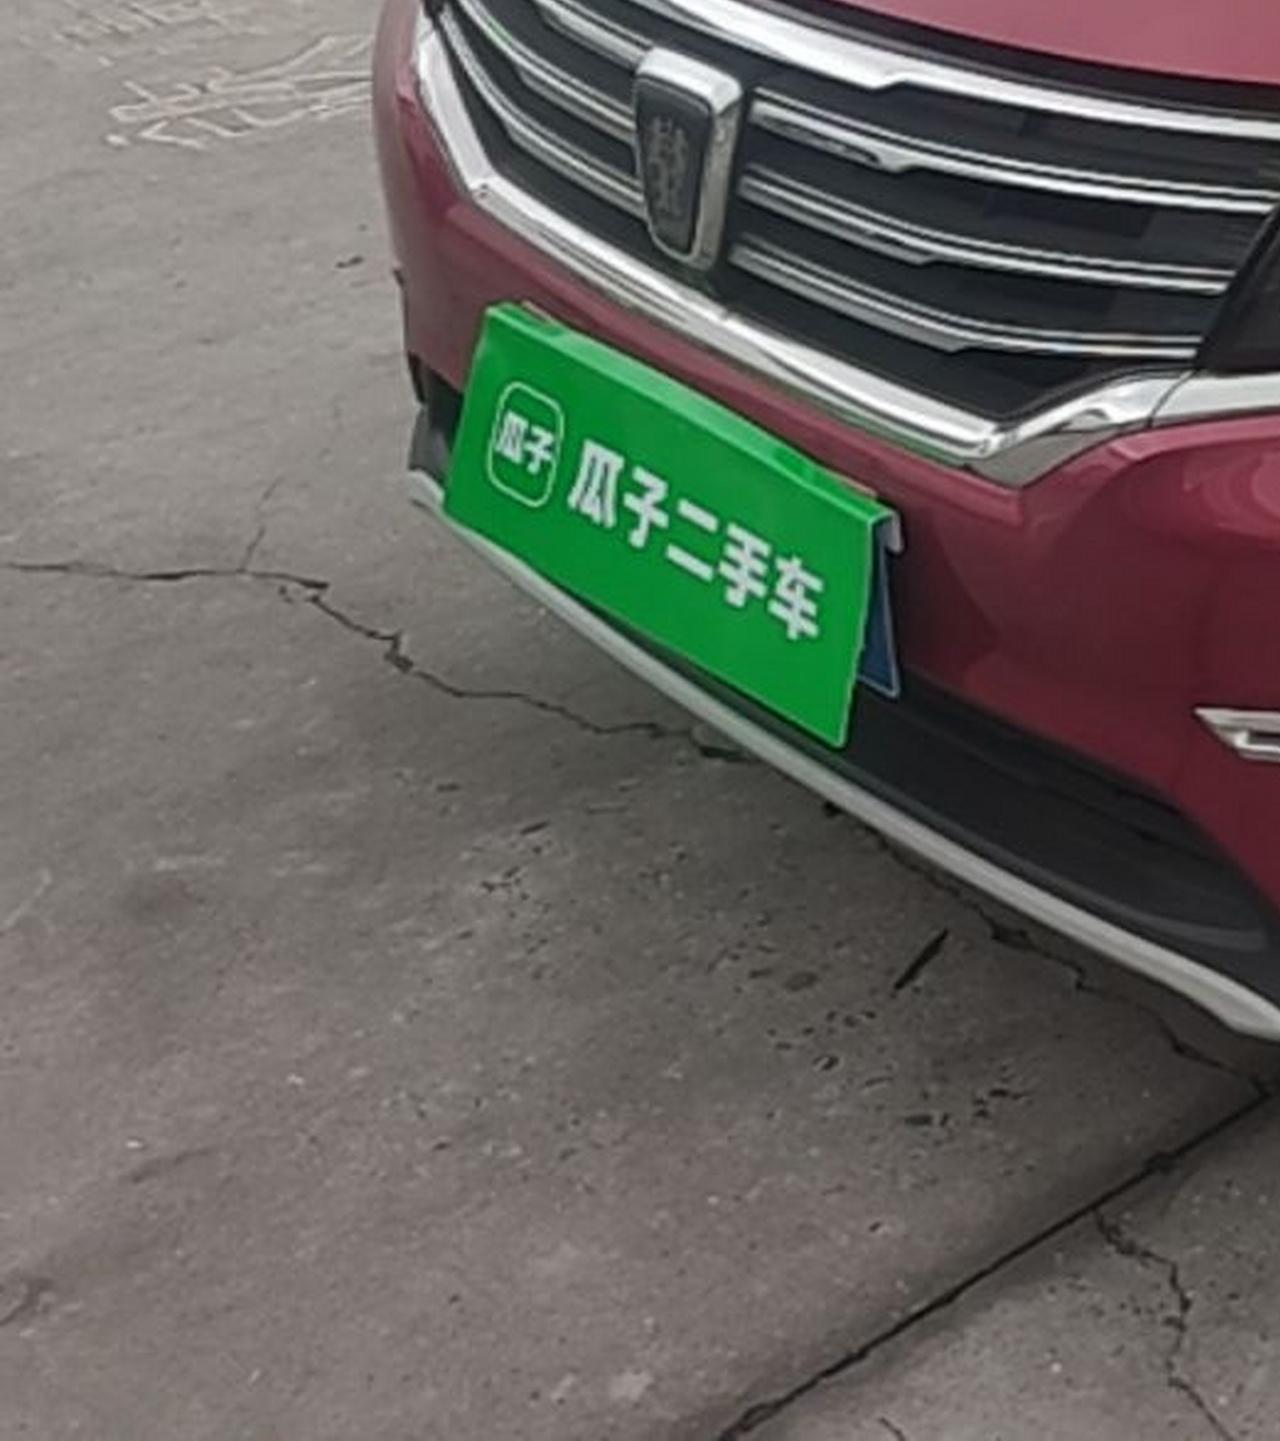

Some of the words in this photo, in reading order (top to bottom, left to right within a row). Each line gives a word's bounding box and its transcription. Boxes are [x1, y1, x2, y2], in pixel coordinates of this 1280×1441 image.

[495, 411, 555, 474] 瓜子
[567, 438, 825, 641] 瓜子二手车
